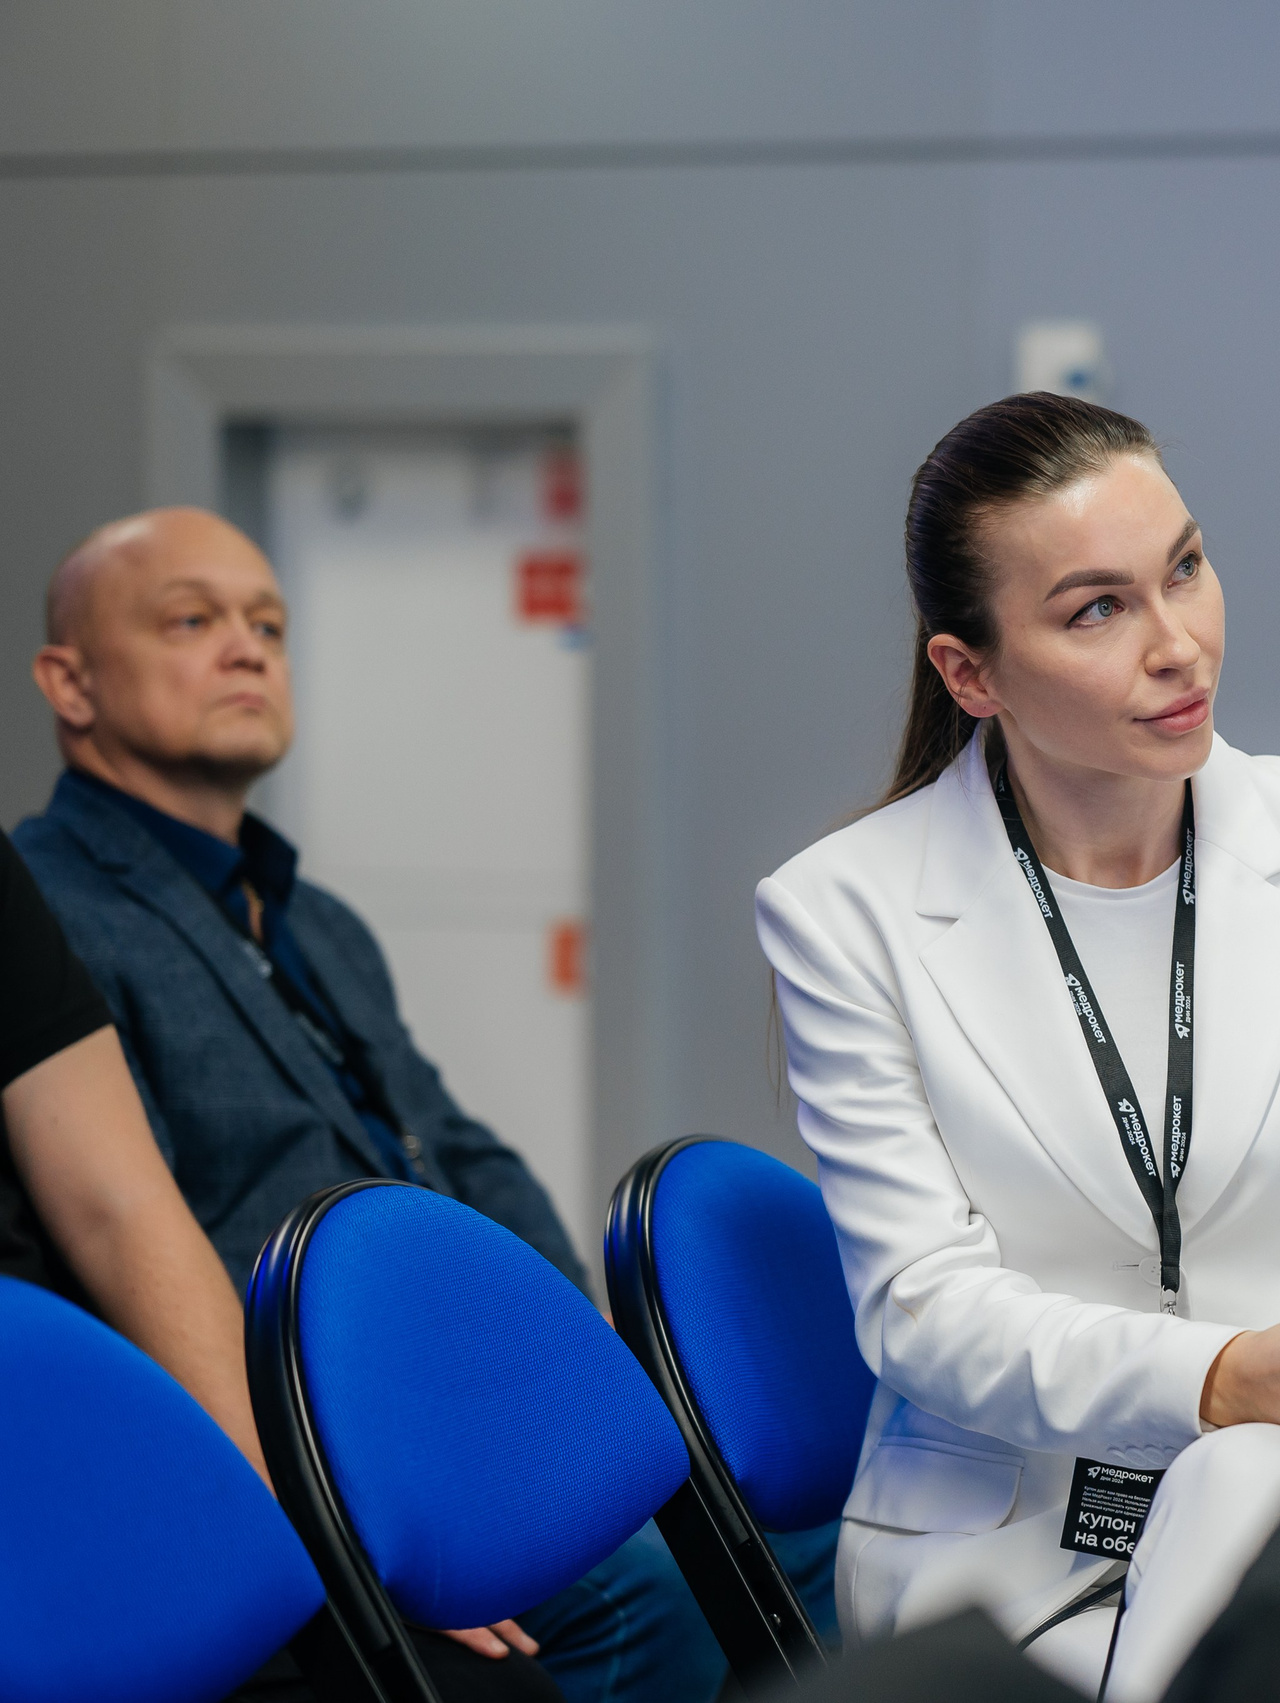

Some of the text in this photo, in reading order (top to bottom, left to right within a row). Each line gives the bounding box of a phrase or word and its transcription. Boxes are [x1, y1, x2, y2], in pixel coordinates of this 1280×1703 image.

[1175, 961, 1185, 1023] медрокет
[1075, 986, 1106, 1044] медрокет
[1126, 1130, 1136, 1145] 2024
[1129, 1112, 1157, 1176] медрокет
[1171, 1095, 1182, 1161] медрокет
[1101, 1467, 1154, 1483] медрокет
[1078, 1511, 1136, 1533] купон
[1074, 1531, 1136, 1554] на обе
